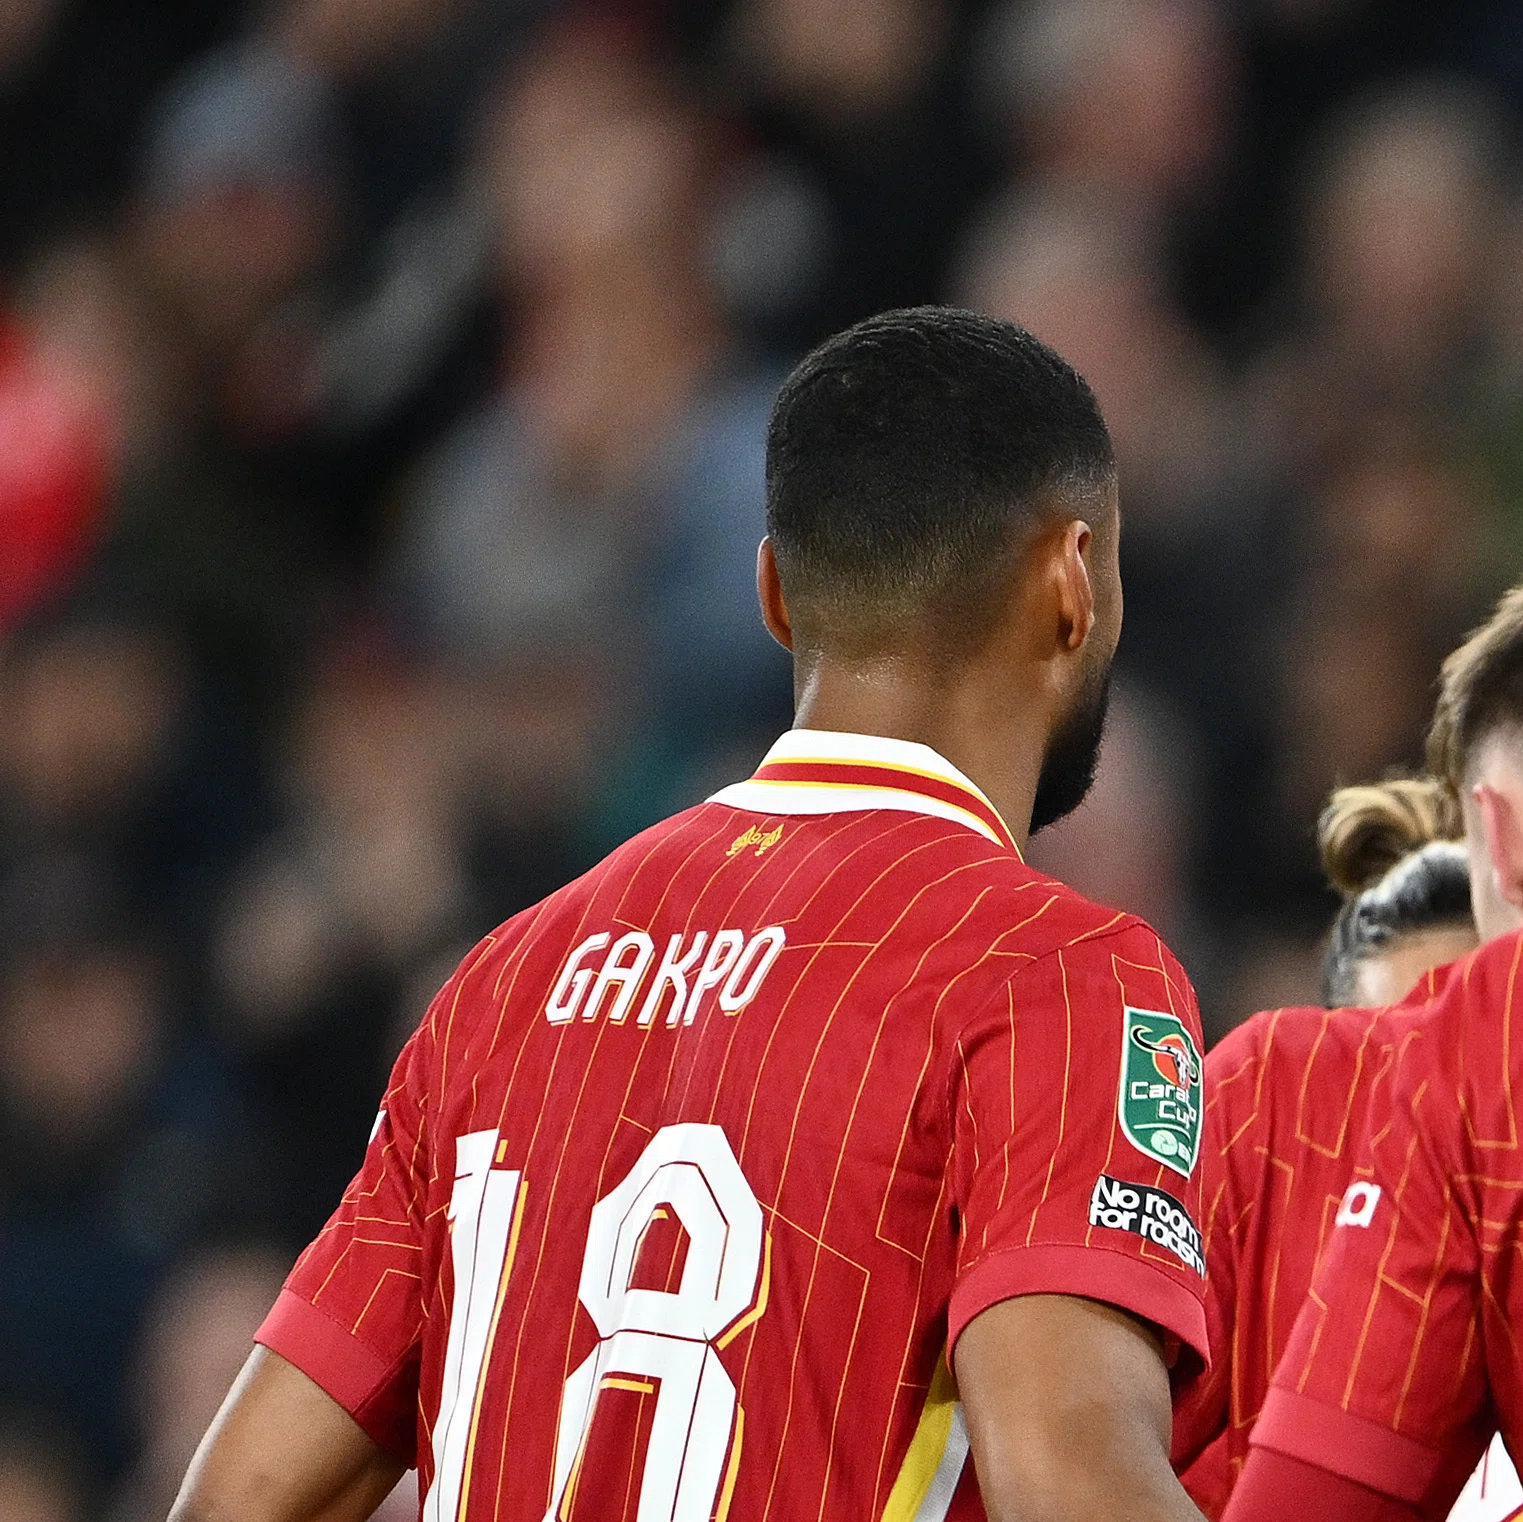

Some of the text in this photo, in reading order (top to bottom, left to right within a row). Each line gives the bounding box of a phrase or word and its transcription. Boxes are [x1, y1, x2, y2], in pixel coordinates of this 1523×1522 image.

[545, 926, 787, 1030] GAKPO
[1130, 1081, 1191, 1104] Cara
[1089, 1202, 1138, 1230] for
[1095, 1175, 1202, 1251] No room
